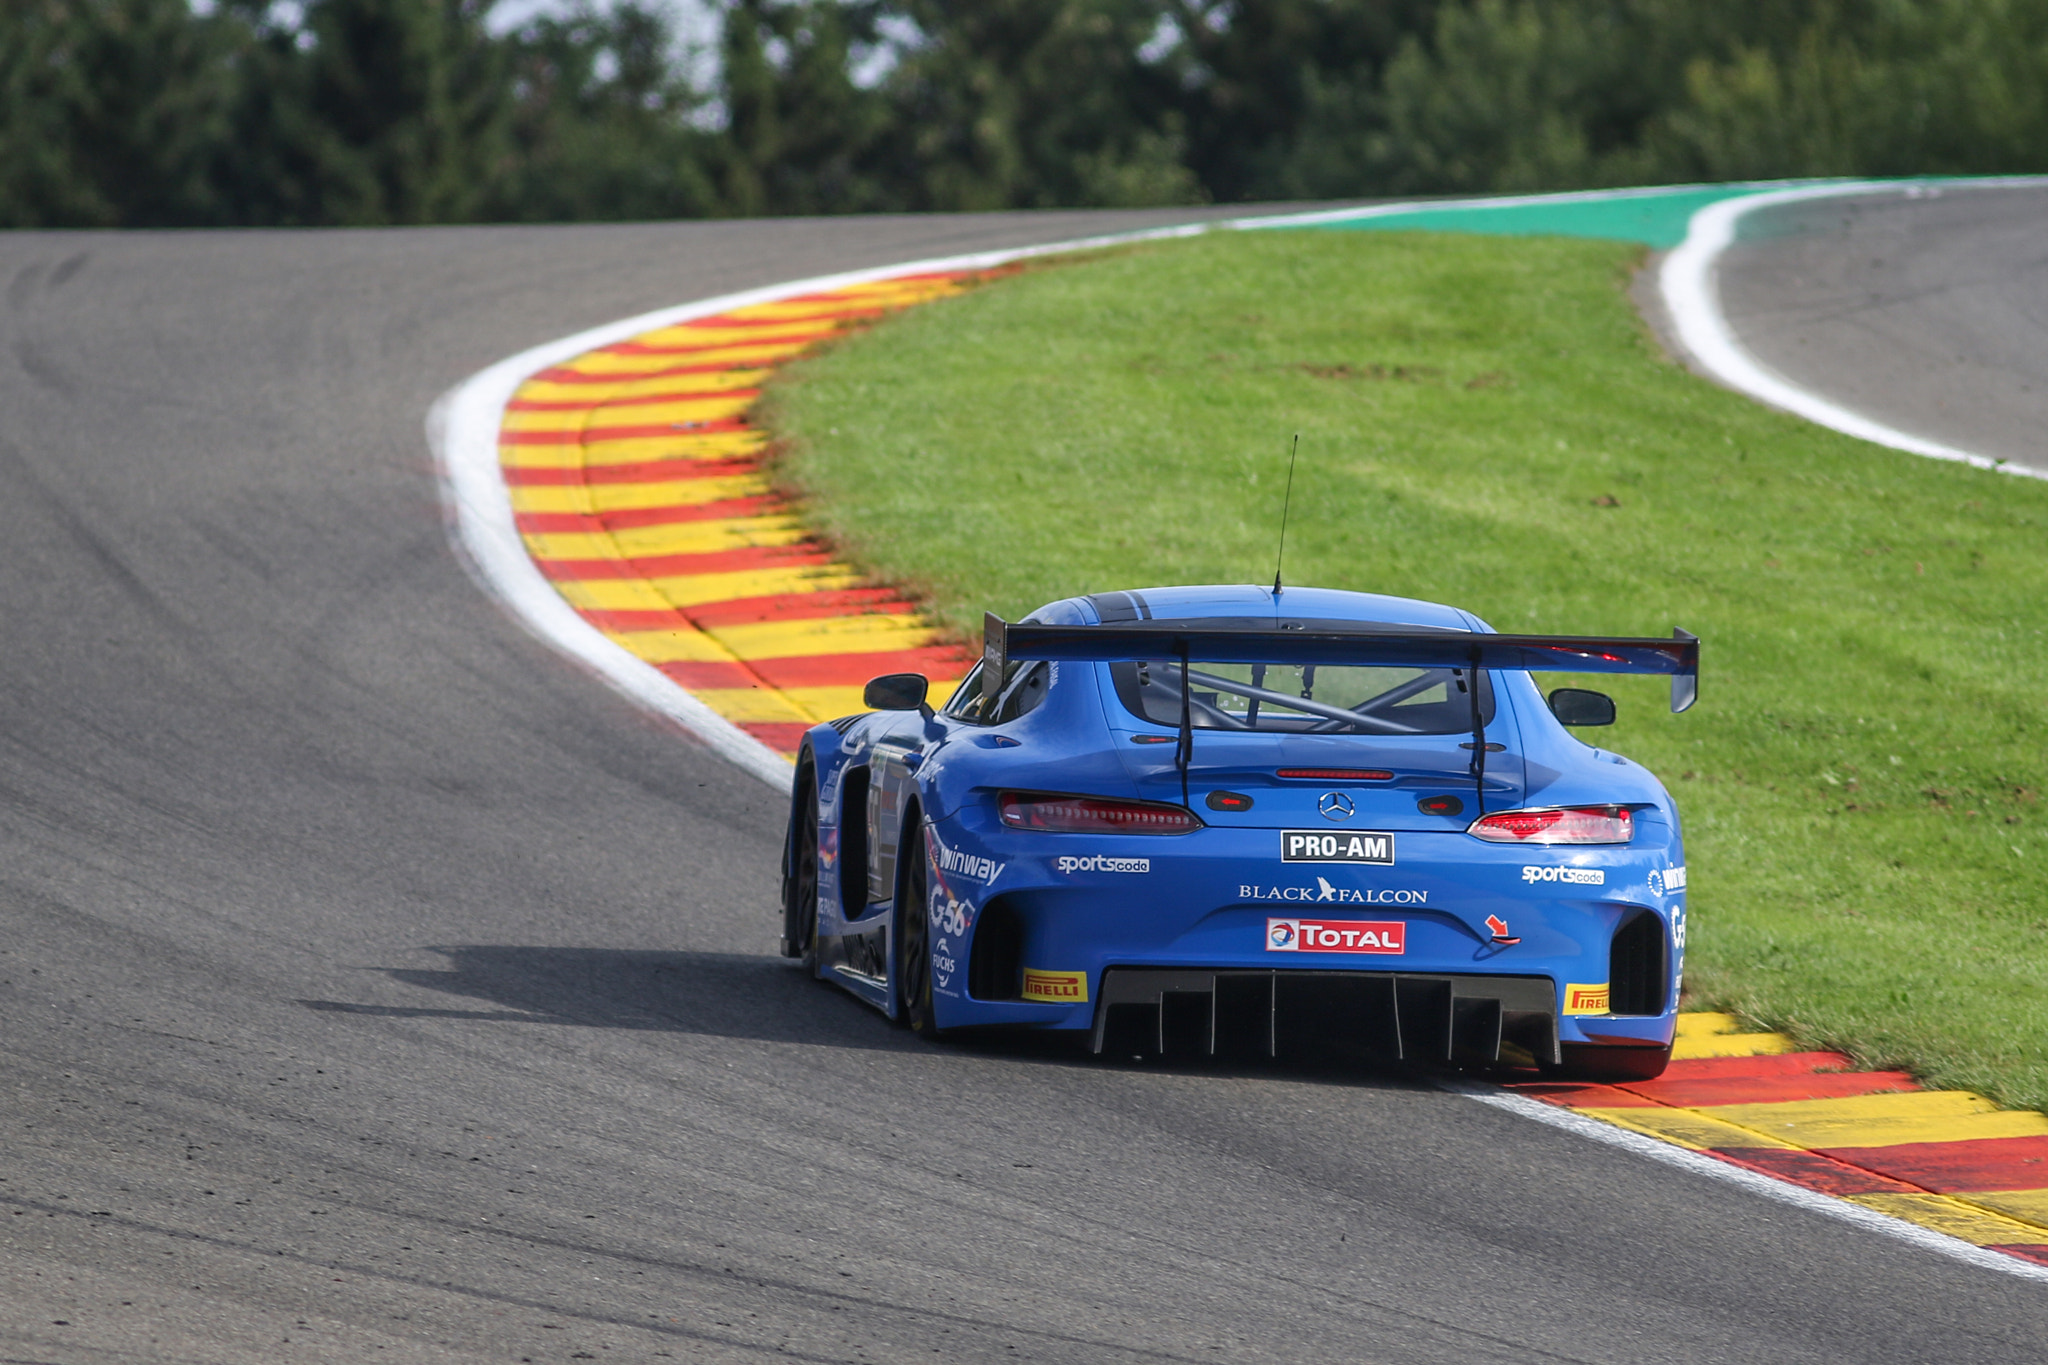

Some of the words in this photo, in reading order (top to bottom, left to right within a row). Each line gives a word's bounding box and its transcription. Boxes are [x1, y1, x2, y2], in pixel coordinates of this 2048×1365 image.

[1289, 835, 1388, 860] PRO-AM
[939, 844, 1006, 887] winway
[1238, 884, 1315, 902] BLACK
[1338, 887, 1429, 905] FALCON
[1300, 924, 1401, 949] TOTAL
[932, 953, 955, 974] FUCHS
[1025, 975, 1079, 997] PIRELLI
[1572, 989, 1610, 1009] PIRELL
